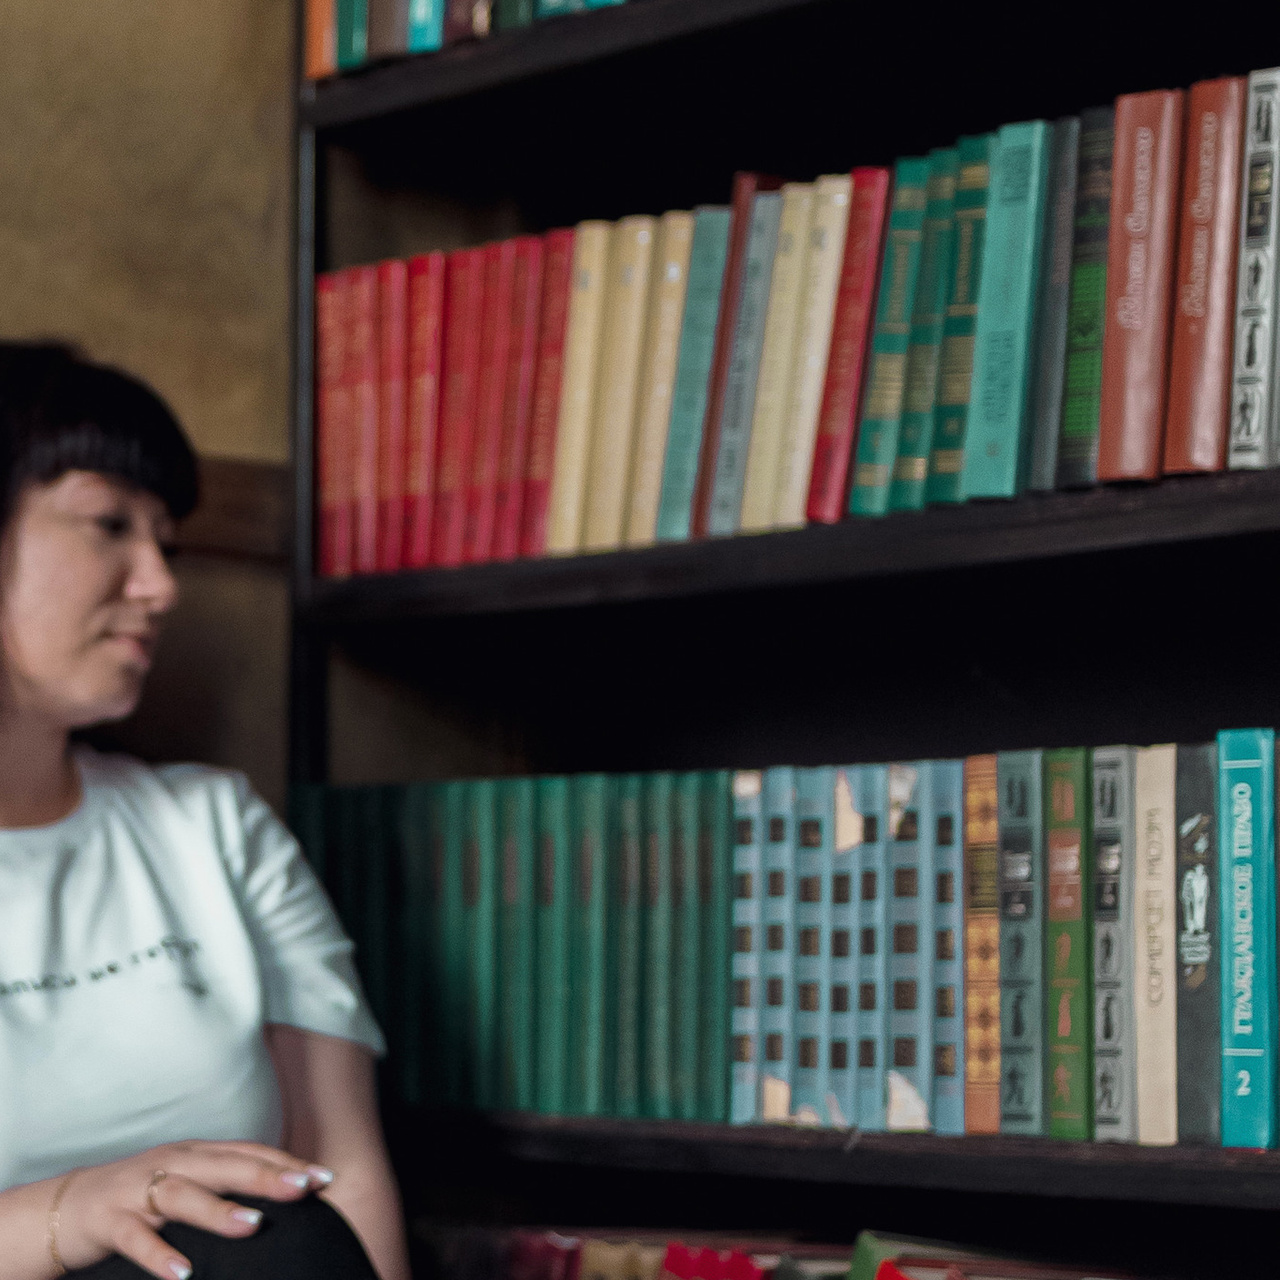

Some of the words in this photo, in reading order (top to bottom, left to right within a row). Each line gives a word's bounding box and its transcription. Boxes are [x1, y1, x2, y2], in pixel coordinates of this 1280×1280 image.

[1232, 782, 1253, 857] ПРАВО
[1233, 862, 1254, 1037] ГРАЖДАНСКОЕ
[1235, 1070, 1252, 1097] 2
